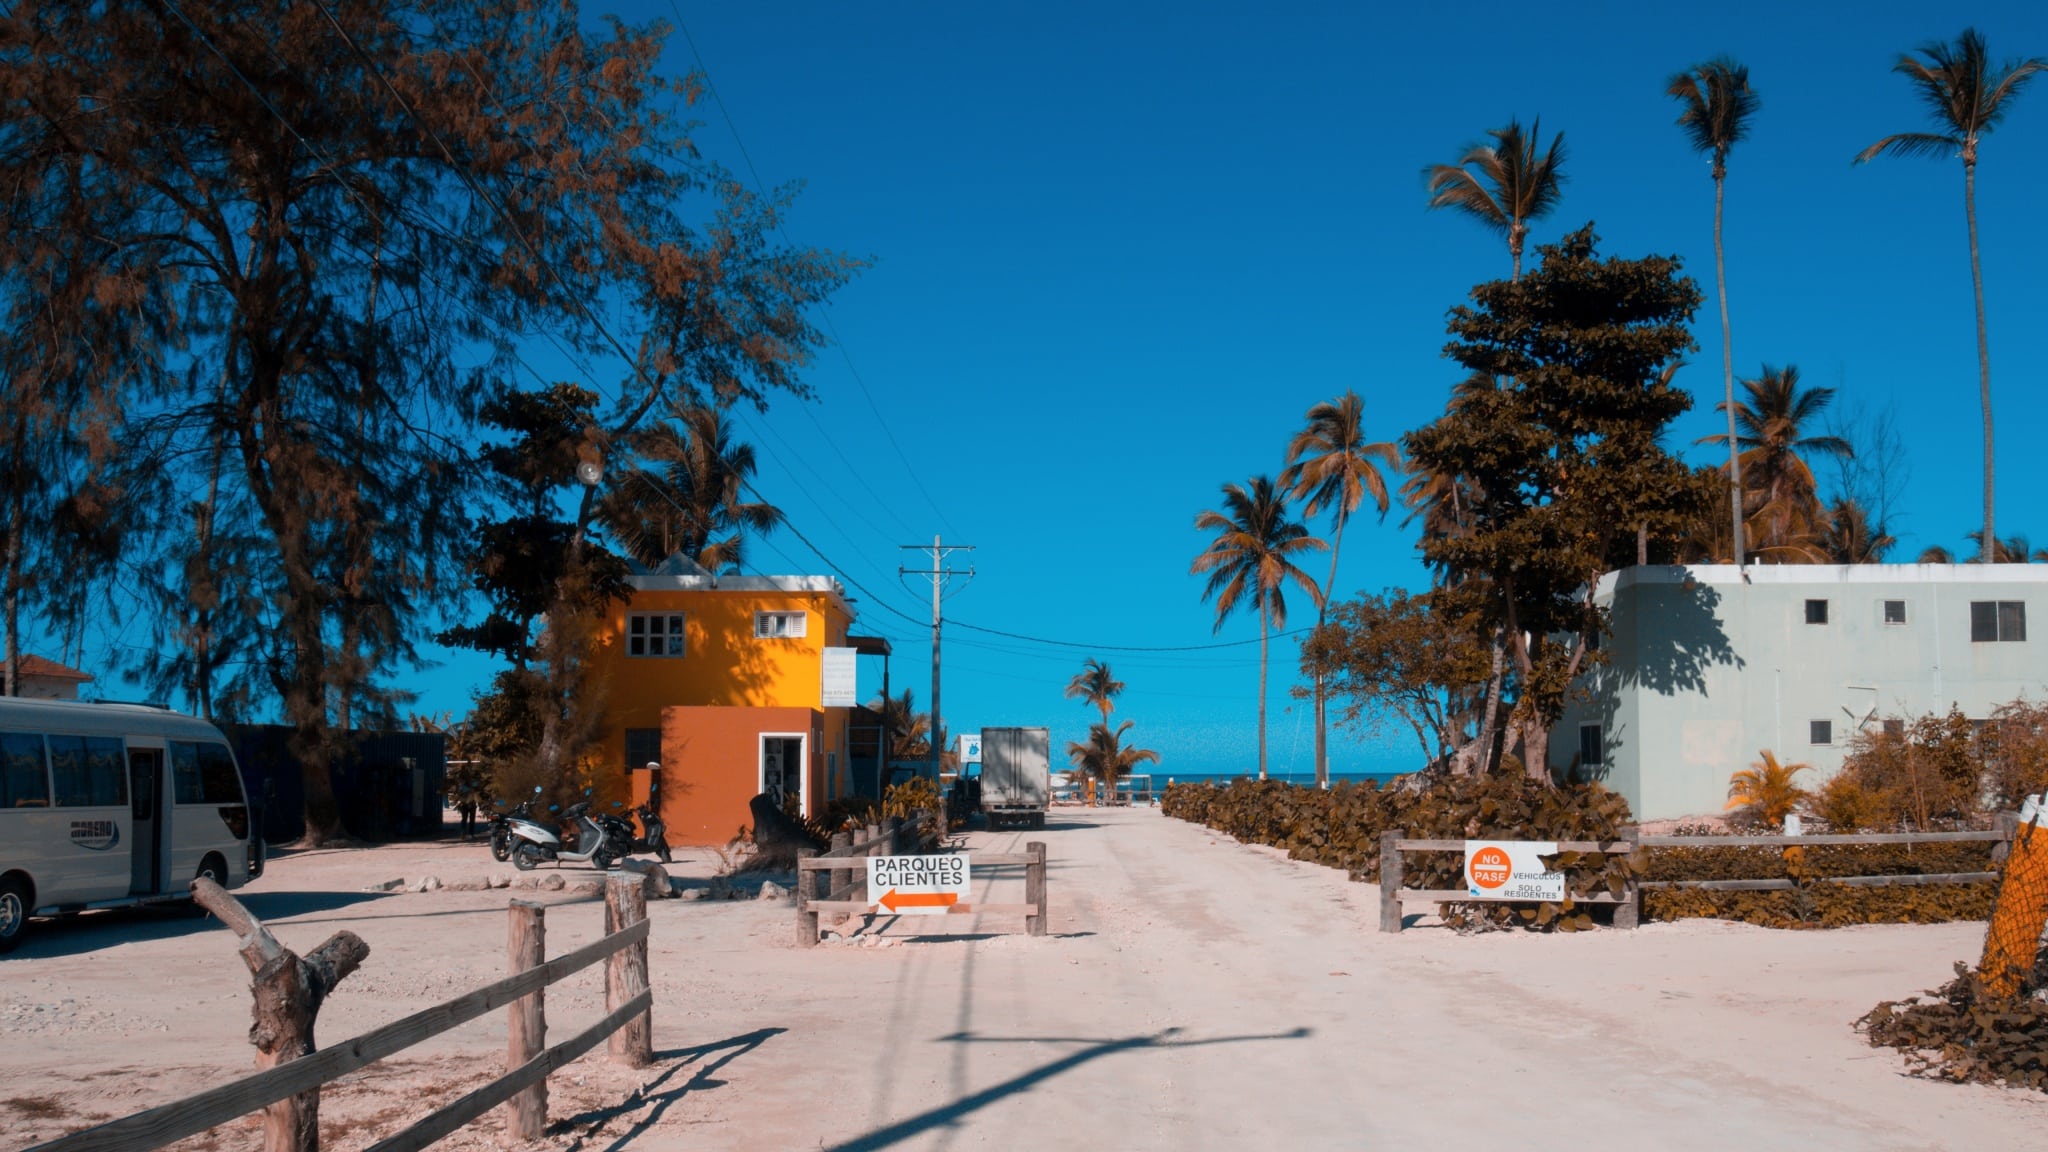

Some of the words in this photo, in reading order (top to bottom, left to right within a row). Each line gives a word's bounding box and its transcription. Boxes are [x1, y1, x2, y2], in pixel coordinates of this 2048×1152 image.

[1482, 854, 1500, 864] NO
[876, 857, 963, 872] PARQUEO
[876, 871, 963, 886] CLIENTES
[1475, 872, 1506, 882] PASE
[1518, 884, 1542, 892] SOLO
[1504, 890, 1557, 899] RESIDENTES
